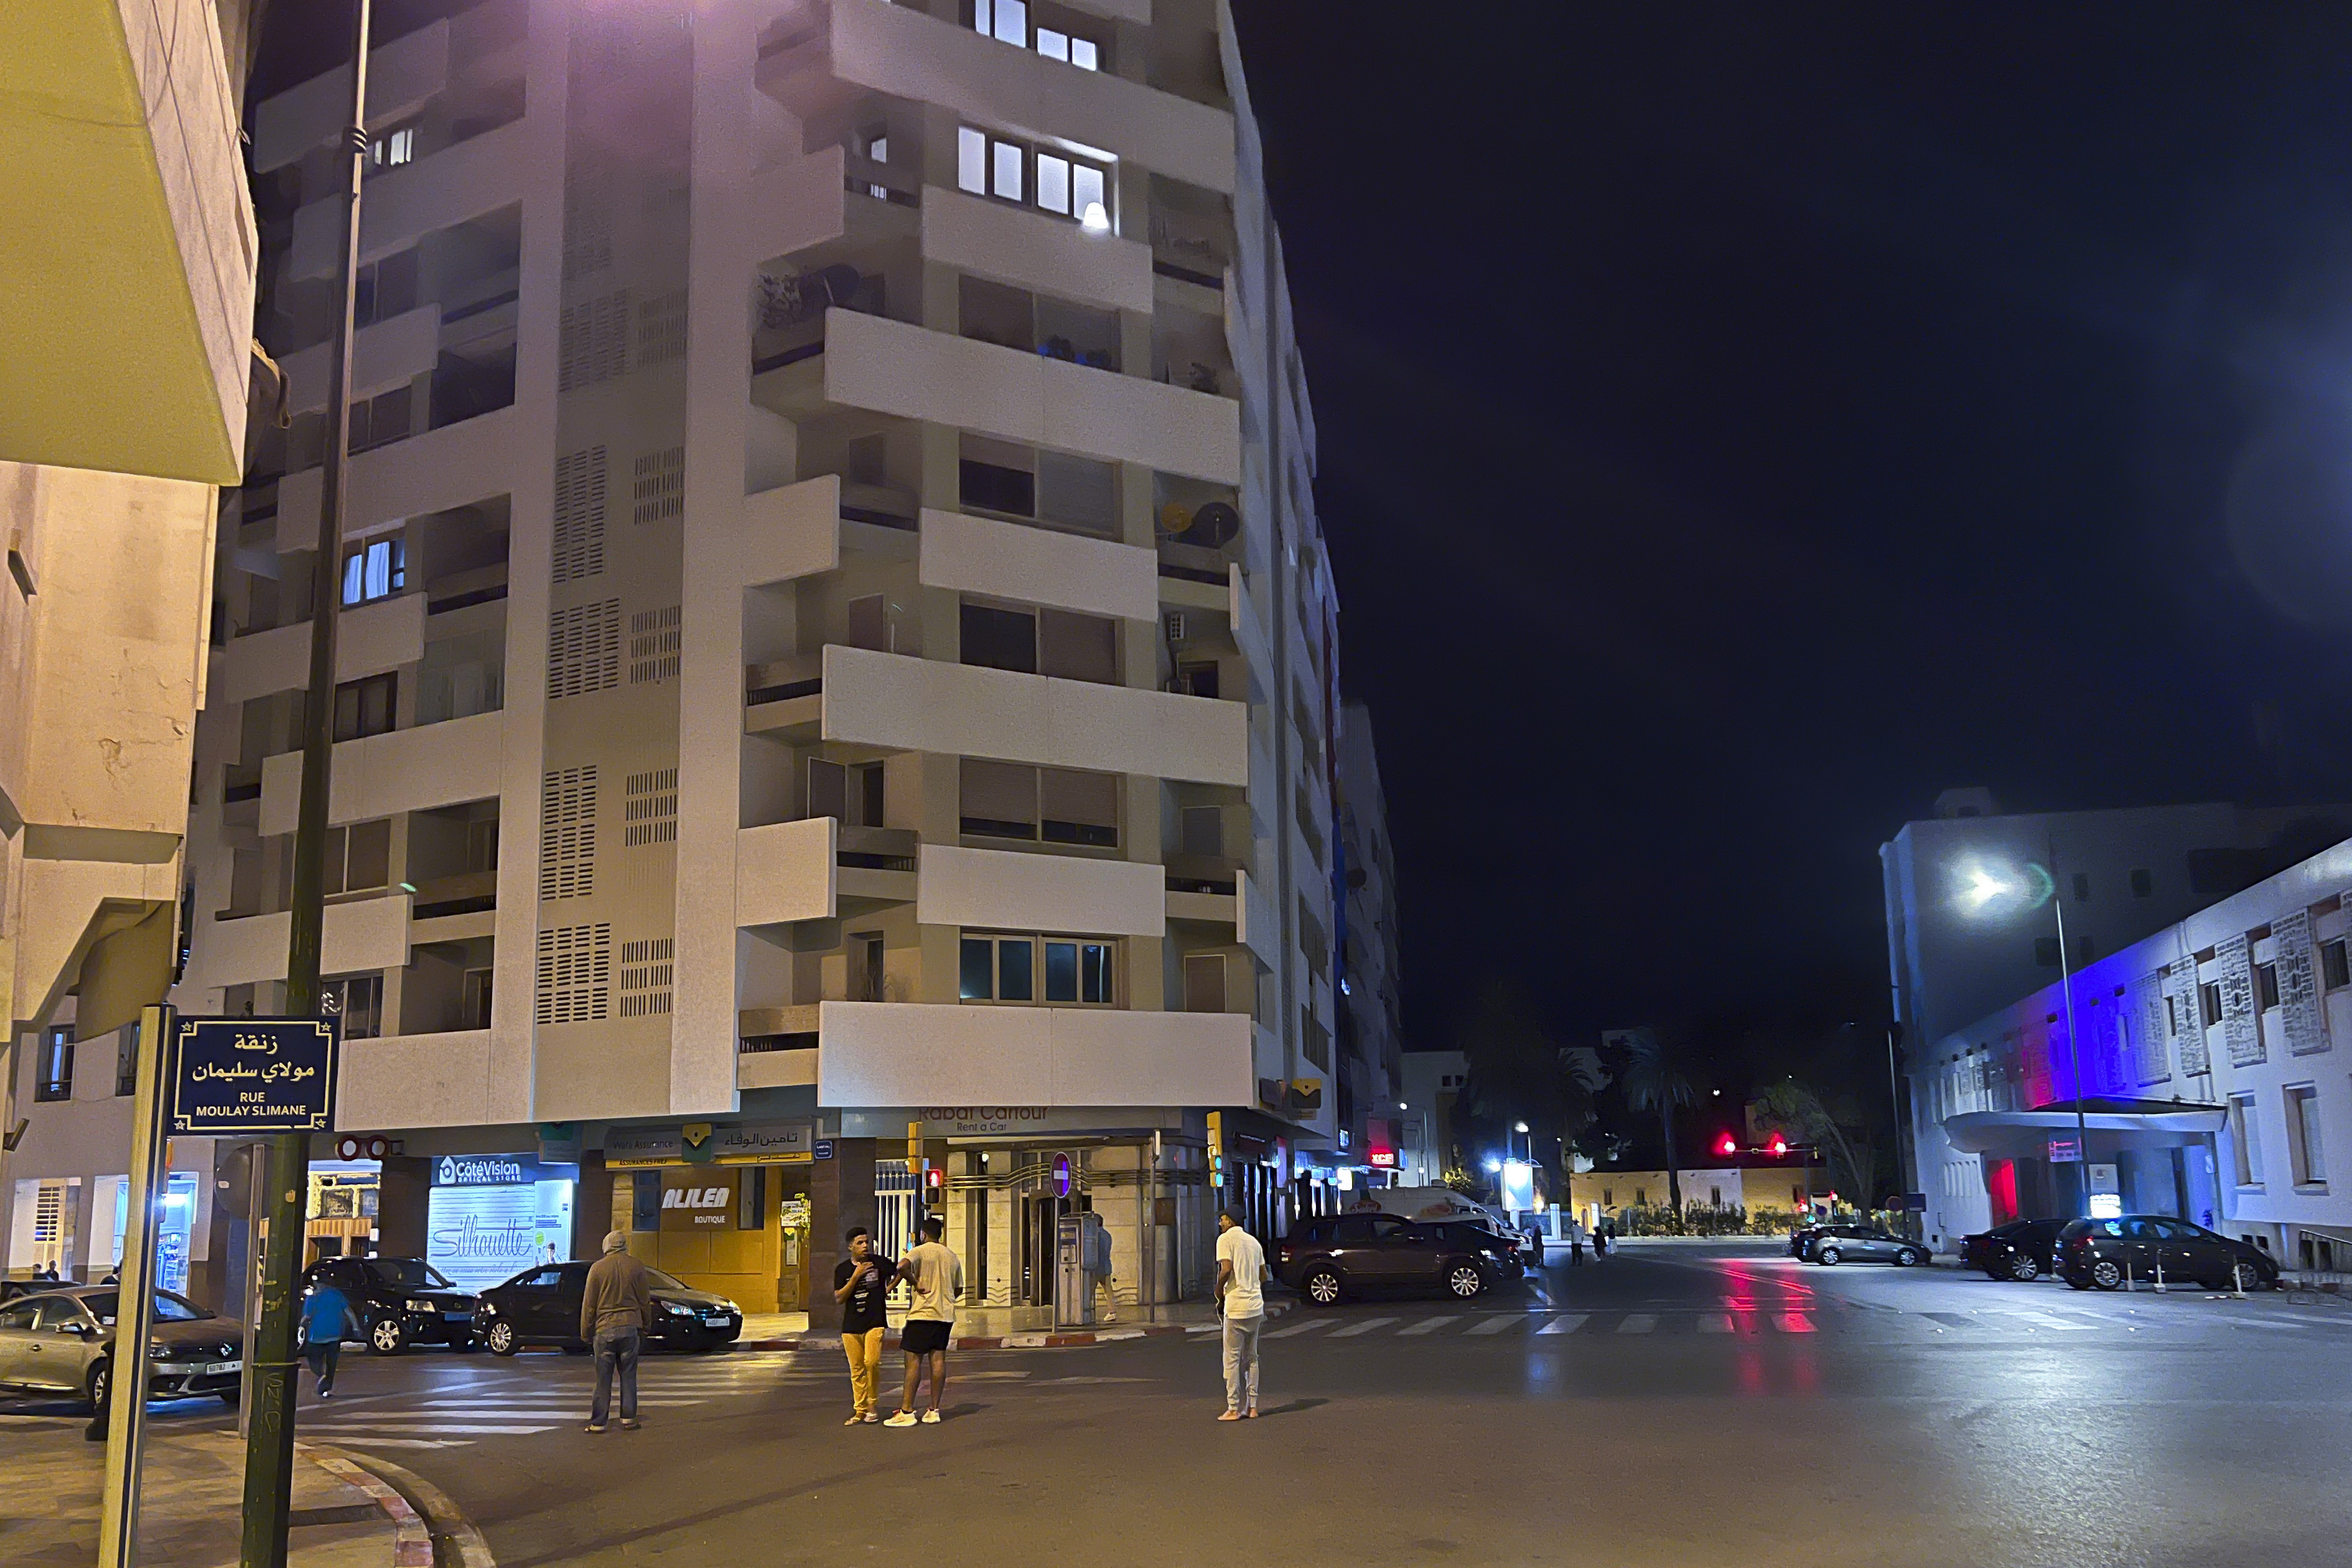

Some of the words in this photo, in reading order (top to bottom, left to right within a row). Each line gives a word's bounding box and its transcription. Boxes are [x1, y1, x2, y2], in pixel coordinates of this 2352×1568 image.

[235, 1034, 278, 1054] زنقة
[192, 1062, 258, 1081] سليمان
[261, 1061, 315, 1083] مولاي
[240, 1092, 265, 1103] RUE
[196, 1106, 250, 1116] MOULAY
[252, 1105, 306, 1116] SLIMANE
[956, 1122, 977, 1131] Rent
[989, 1122, 1007, 1131] Car
[635, 1139, 673, 1149] Assurance
[456, 1160, 520, 1177] CôtéVision
[661, 1187, 730, 1208] ALILEA
[694, 1215, 726, 1224] BOUTIQUE
[431, 1214, 534, 1257] Silhouette
